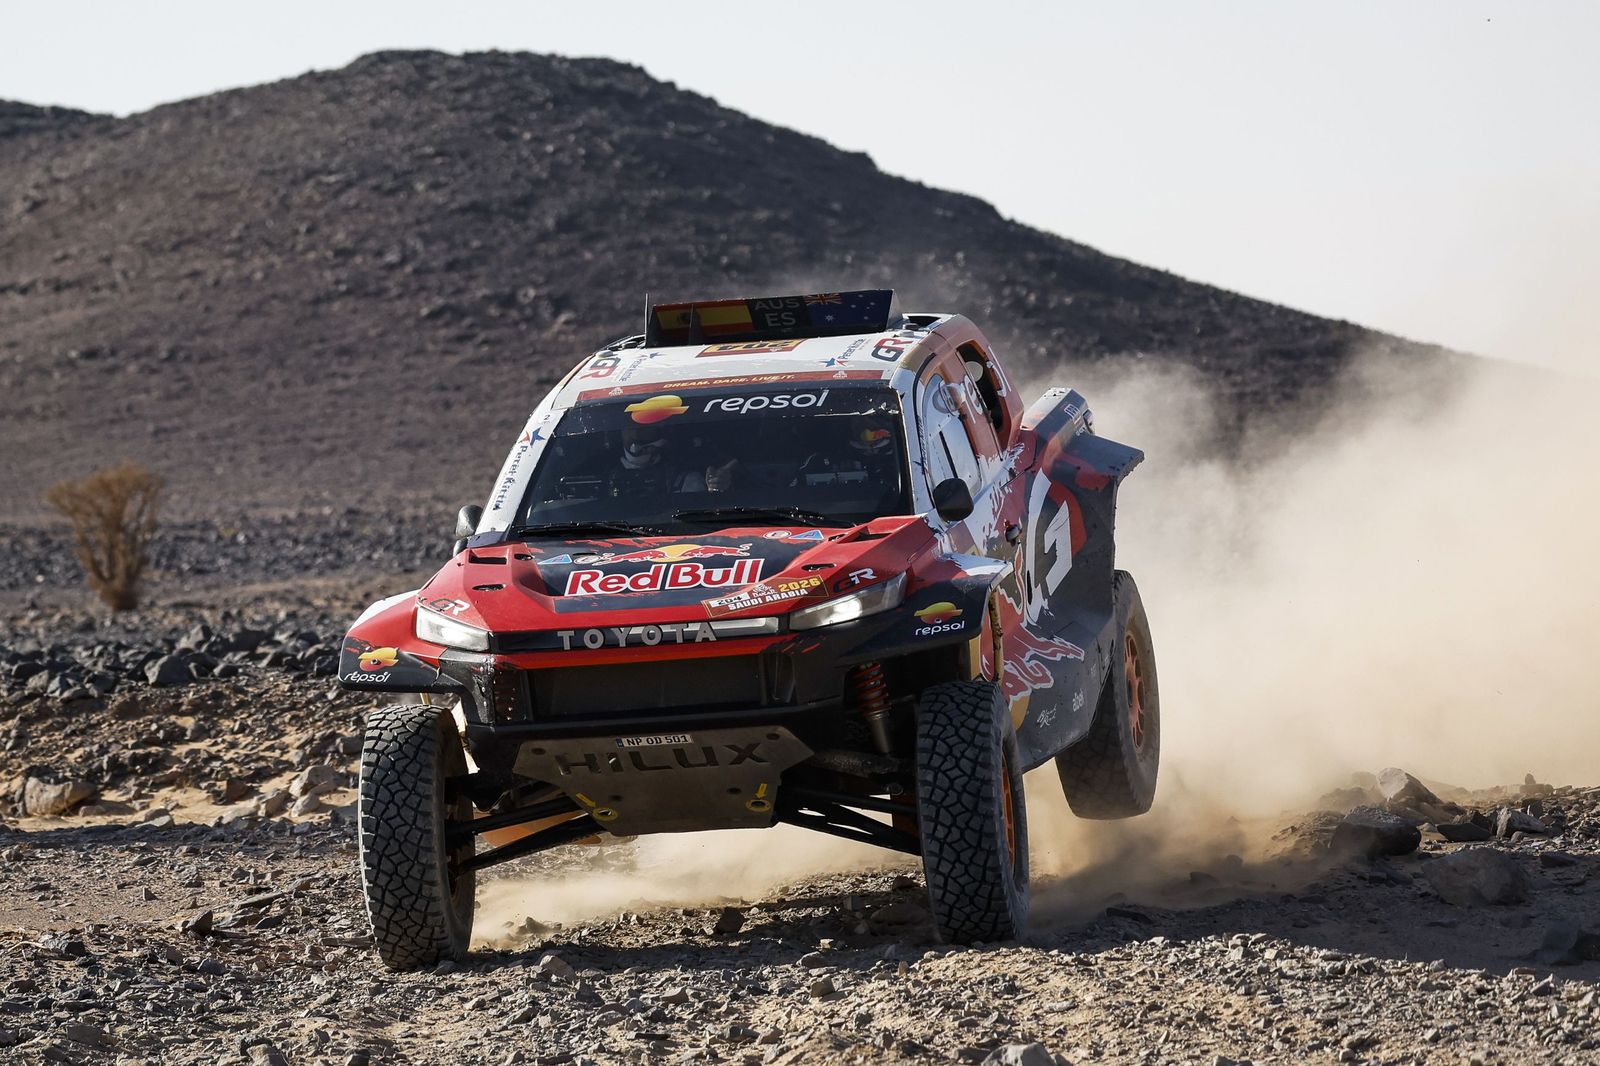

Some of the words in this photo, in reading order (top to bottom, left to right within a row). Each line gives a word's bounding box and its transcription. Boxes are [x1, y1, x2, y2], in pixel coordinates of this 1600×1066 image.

[754, 298, 800, 311] AUS
[765, 311, 797, 327] ES
[703, 389, 829, 414] repsol
[566, 564, 665, 597] Red
[667, 559, 764, 588] Bull
[779, 578, 821, 592] 2026
[833, 568, 877, 593] GR
[728, 598, 763, 611] SAUDI
[766, 588, 808, 602] ARABIA
[557, 622, 717, 651] TOYOTA
[915, 620, 966, 636] repsol
[344, 671, 391, 683] repsol
[627, 737, 642, 746] NP
[665, 735, 688, 744] 501
[554, 742, 767, 775] HILUX
